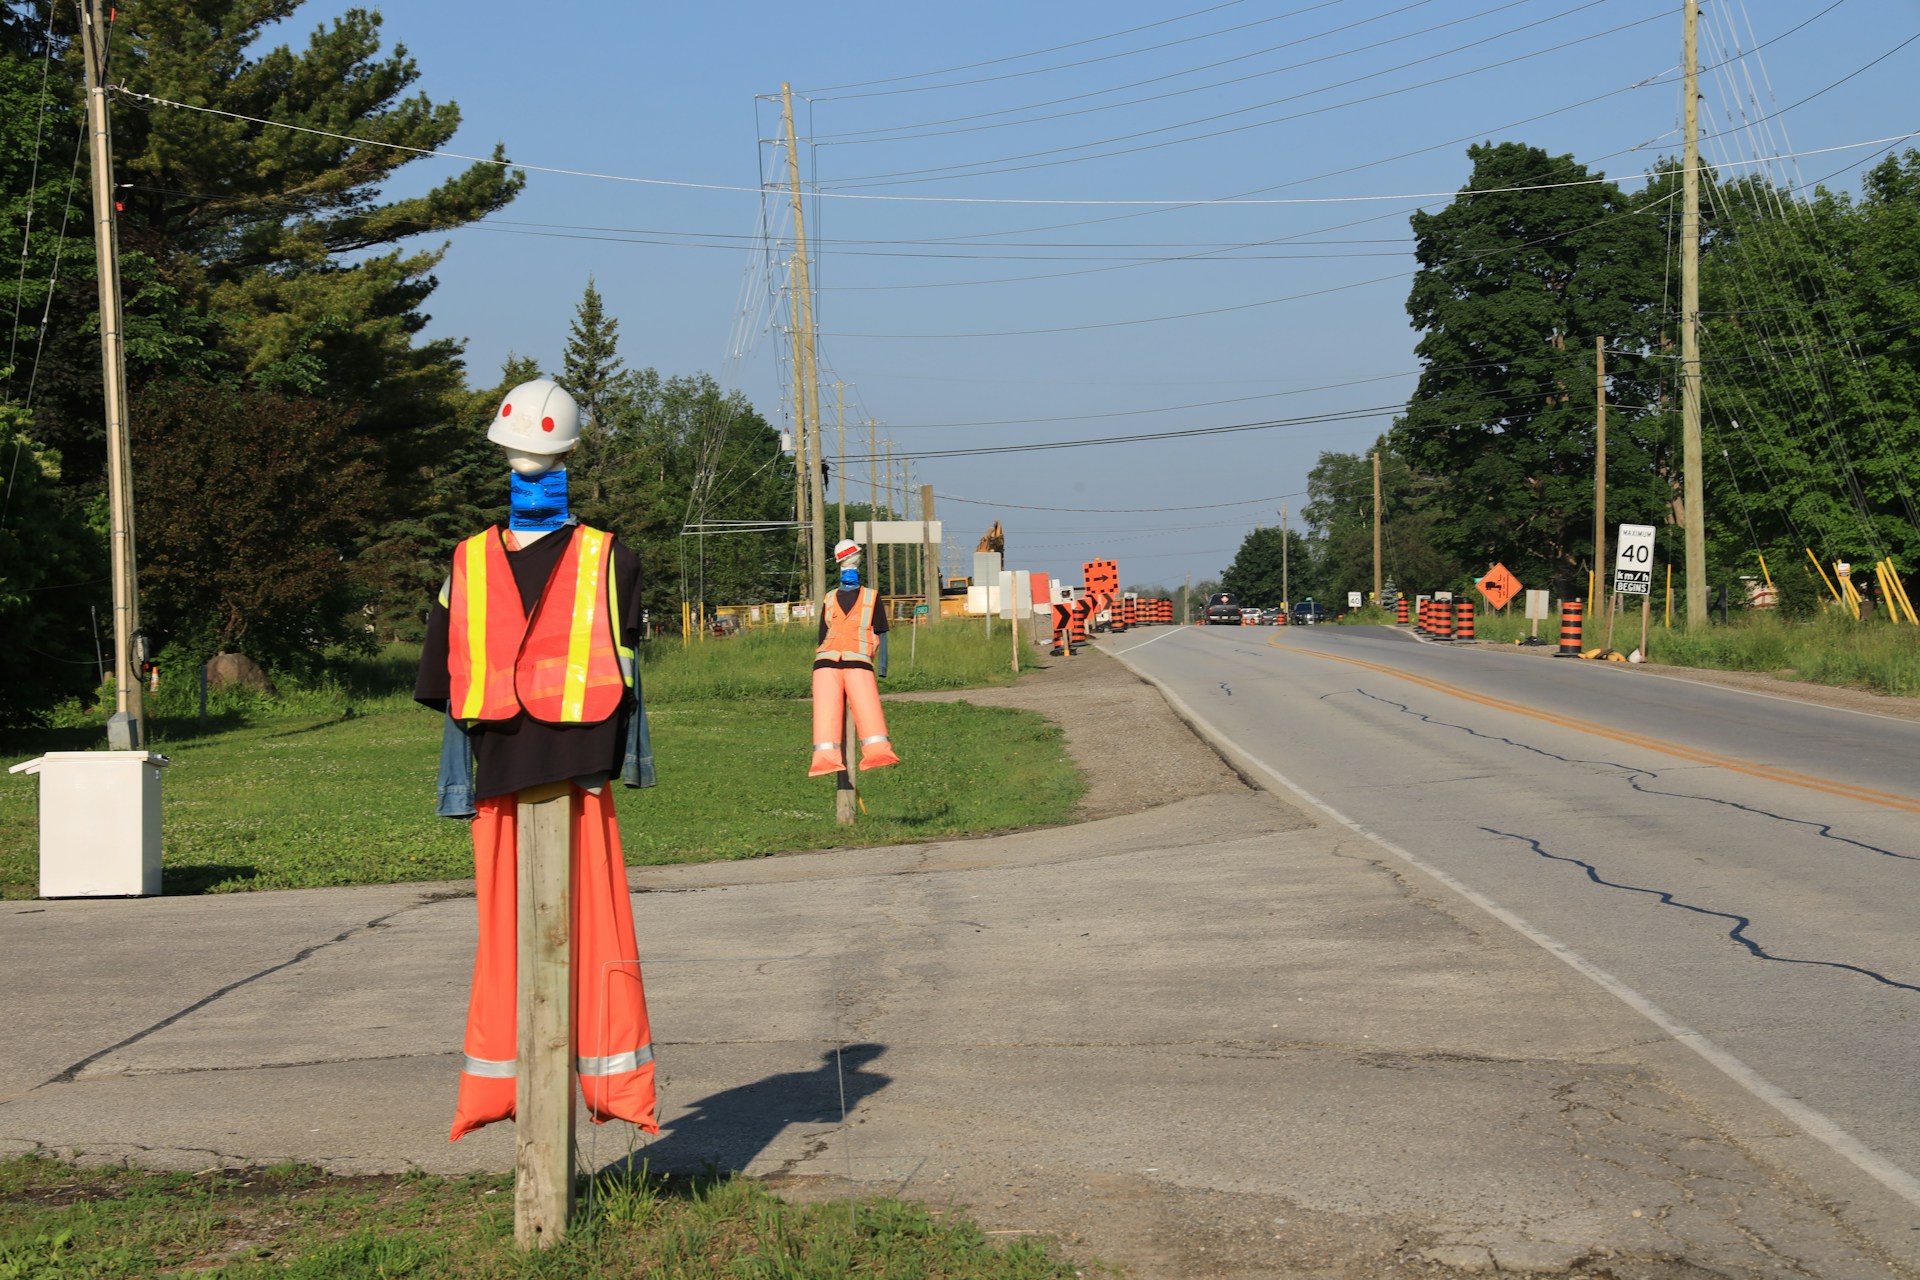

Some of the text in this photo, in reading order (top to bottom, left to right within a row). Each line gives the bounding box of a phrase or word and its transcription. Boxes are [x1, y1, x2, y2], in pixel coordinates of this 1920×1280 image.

[1623, 529, 1652, 538] MAXIMUM
[1621, 544, 1649, 564] 40
[1616, 570, 1649, 582] km/h
[1617, 582, 1647, 593] BEGINS
